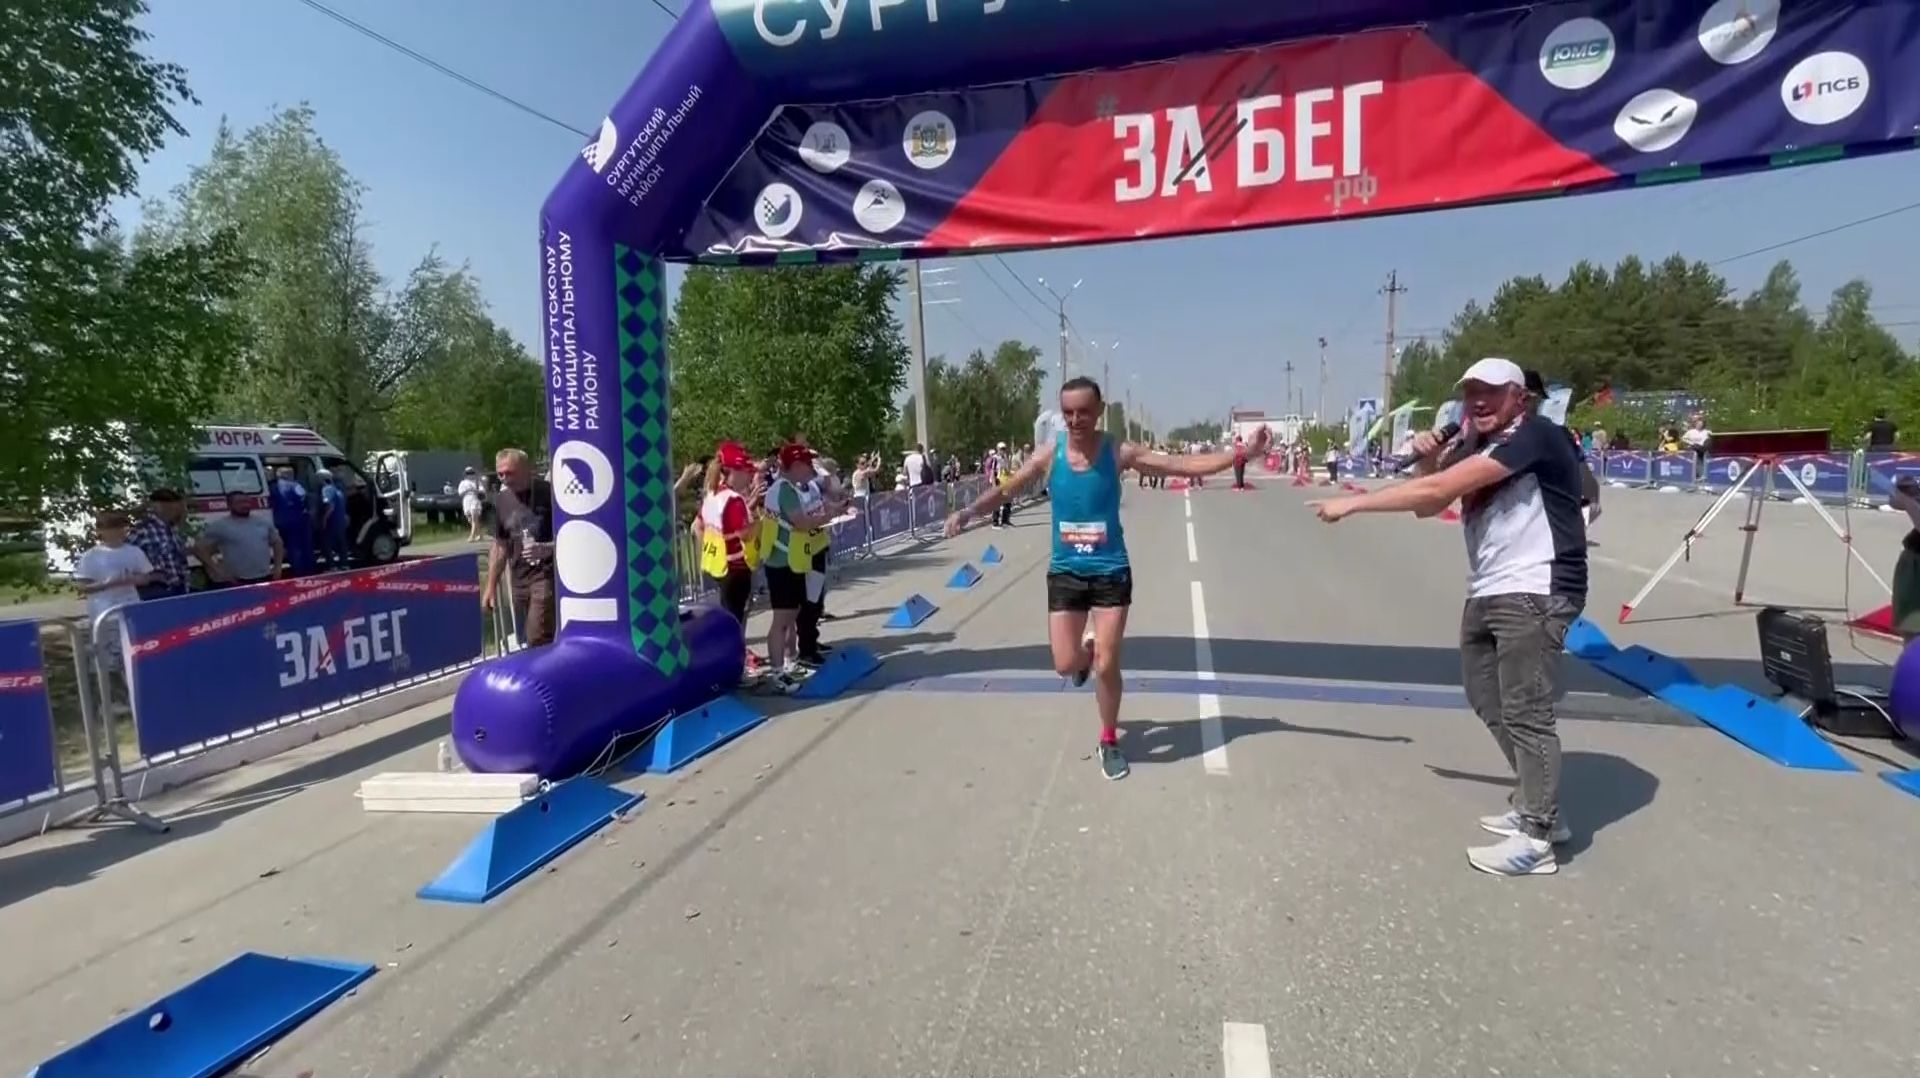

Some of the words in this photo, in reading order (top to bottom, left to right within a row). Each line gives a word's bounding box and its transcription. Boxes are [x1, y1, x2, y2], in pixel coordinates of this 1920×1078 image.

[1553, 43, 1601, 61] ЮМС
[1817, 76, 1860, 96] ПСБ
[606, 107, 667, 186] СУРГУТСКИЙ
[617, 84, 703, 197] МУНИЦИПАЛЬНЫЙ
[629, 164, 665, 207] РАЙОН
[546, 245, 562, 388] СУРГУТСКОМУ
[558, 230, 580, 430] МУНИЦИПАЛЬНОМУ
[581, 349, 600, 430] РАЙОНУ
[553, 395, 564, 431] ЛЕТ
[214, 431, 265, 446] ЮГРА
[553, 441, 619, 632] 100
[1074, 543, 1094, 554] 74
[189, 606, 266, 637] ЗАБЕГ.РФ
